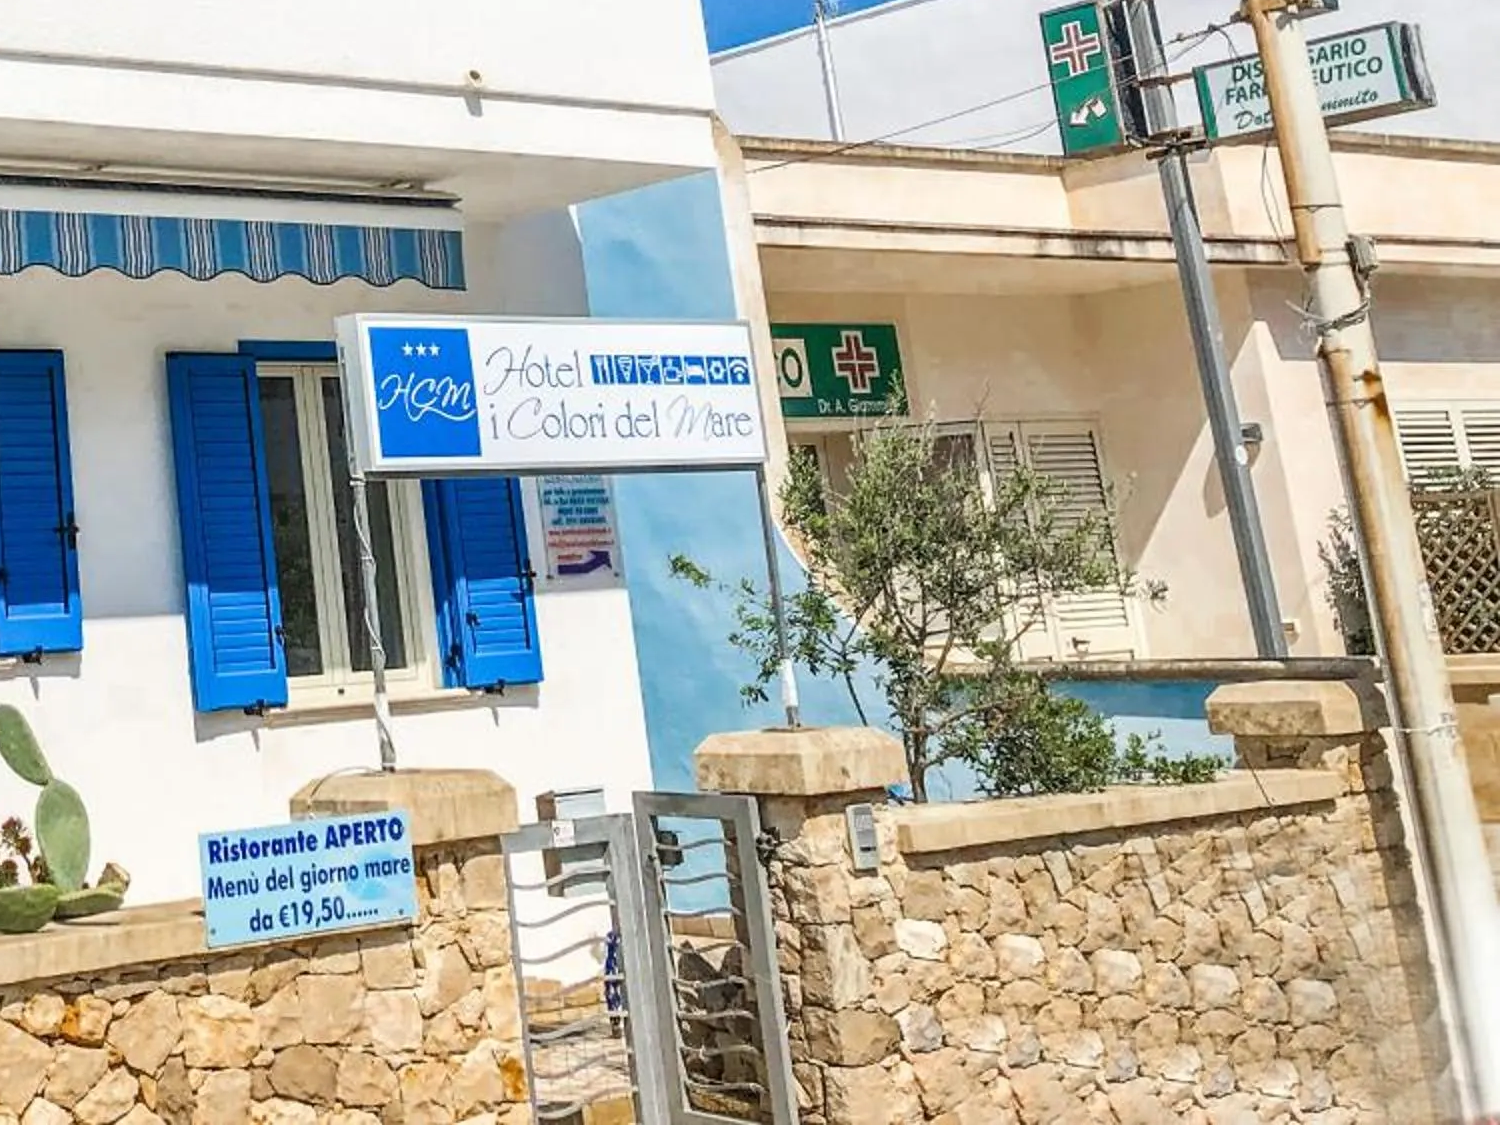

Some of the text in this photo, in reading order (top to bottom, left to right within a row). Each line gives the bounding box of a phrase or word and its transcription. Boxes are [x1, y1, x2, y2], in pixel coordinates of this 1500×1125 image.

[484, 345, 582, 395] Hotel
[378, 373, 476, 422] HCM
[489, 393, 754, 441] i Colori del Mare
[208, 817, 405, 865] Ristorante APERTO
[207, 857, 410, 900] Menù del giorno mare
[250, 907, 273, 932] da
